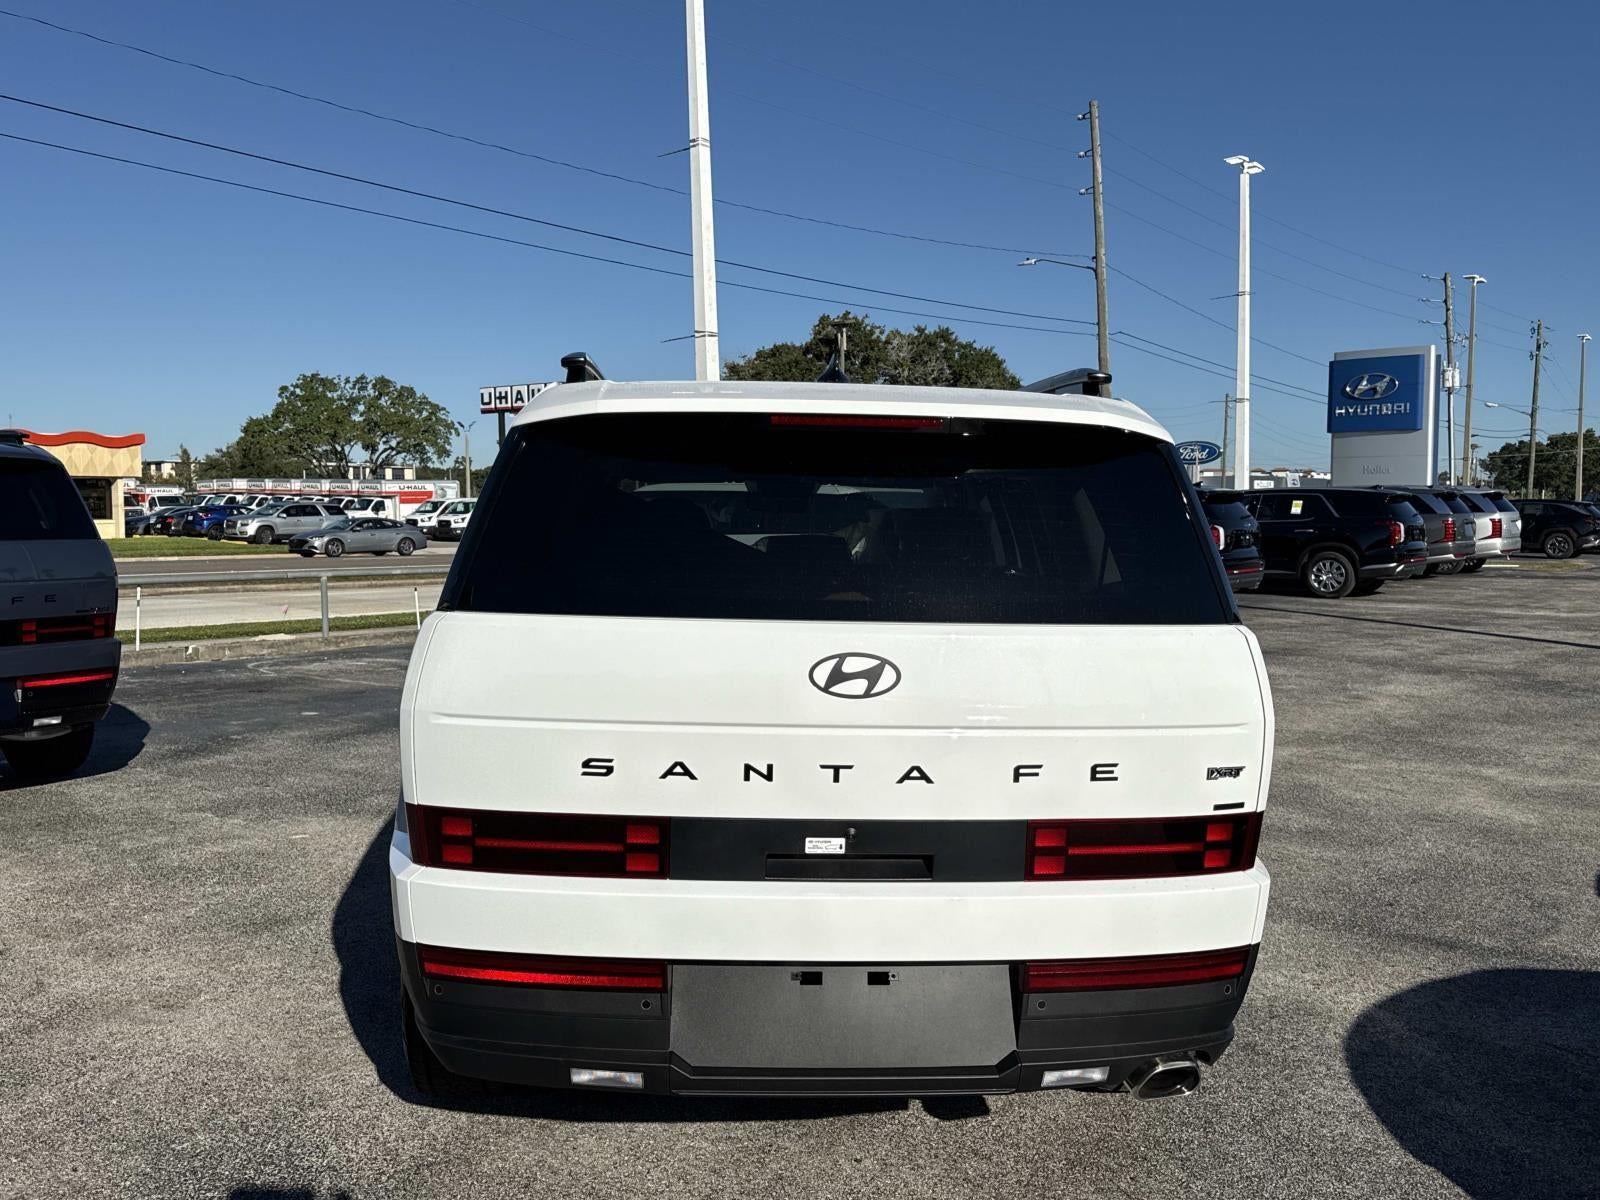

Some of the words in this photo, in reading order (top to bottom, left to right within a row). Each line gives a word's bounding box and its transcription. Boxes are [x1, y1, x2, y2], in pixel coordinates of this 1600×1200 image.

[1335, 402, 1410, 417] HYUNDAI
[1180, 445, 1209, 460] Ford
[581, 757, 934, 784] SANTA
[1013, 763, 1120, 784] FE
[1206, 766, 1246, 780] XRT
